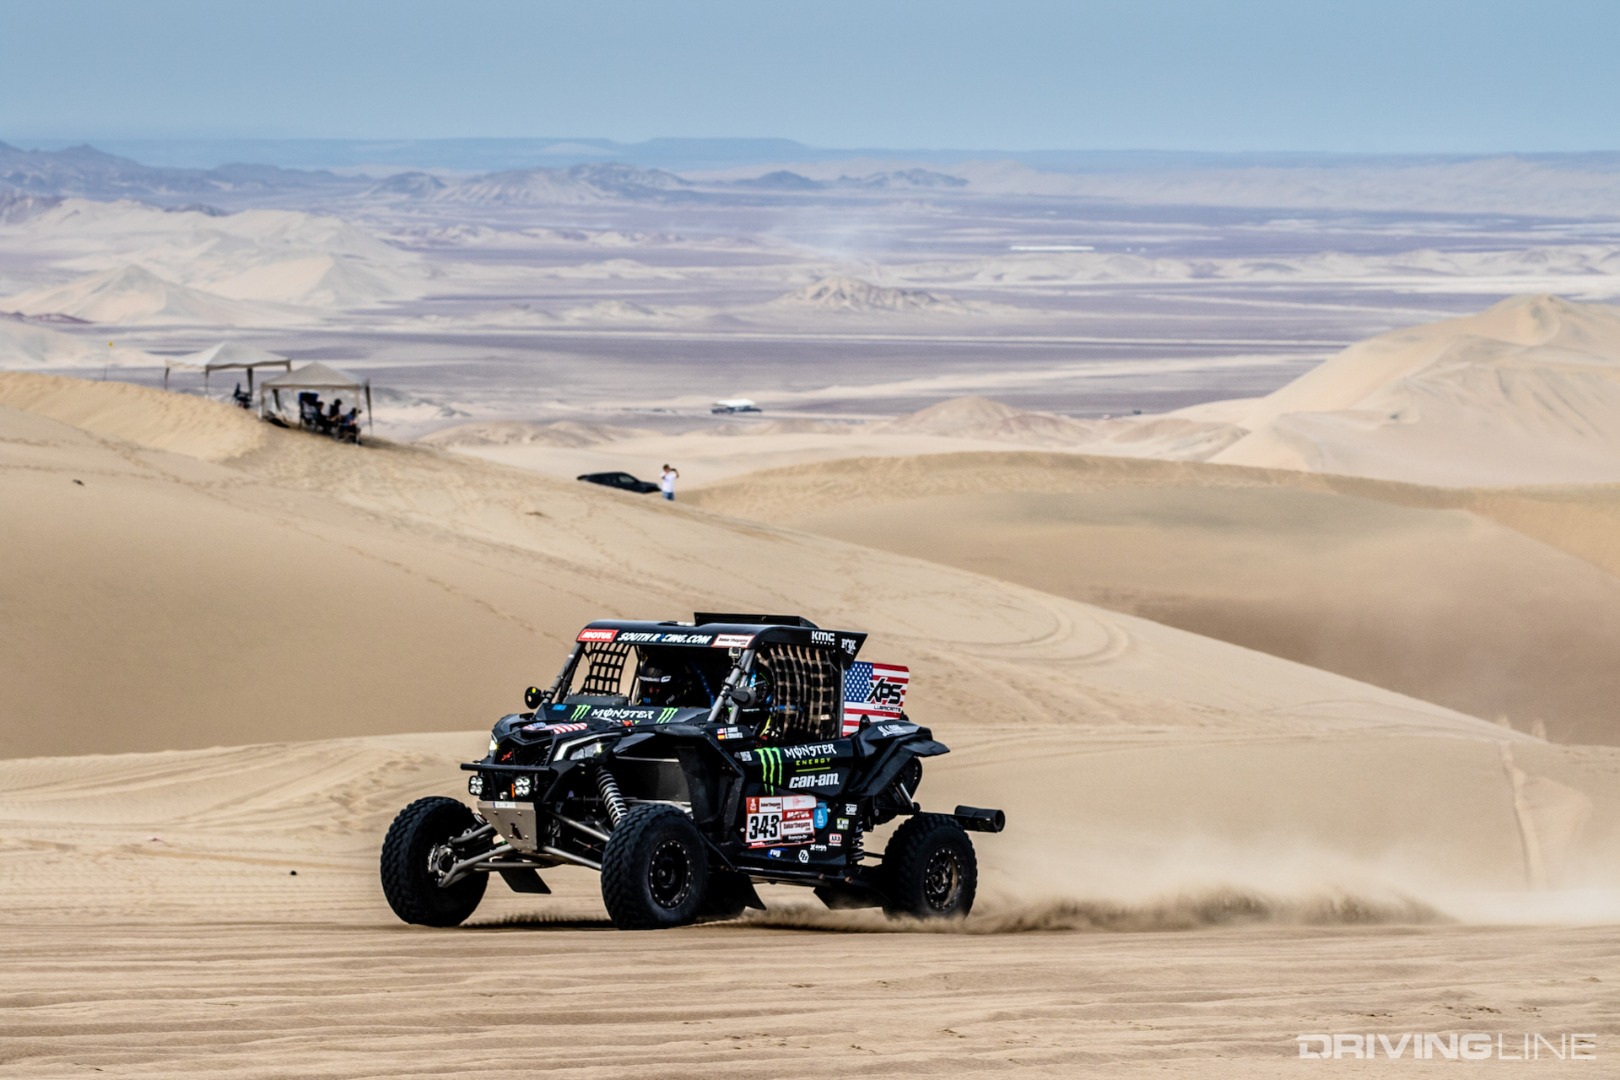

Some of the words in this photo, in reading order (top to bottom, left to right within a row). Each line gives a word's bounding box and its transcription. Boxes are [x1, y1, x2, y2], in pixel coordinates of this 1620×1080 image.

[582, 631, 613, 640] MOTUL
[811, 631, 835, 641] KMC
[866, 678, 903, 705] XPS
[591, 707, 655, 719] MONSTER
[784, 743, 837, 759] MONSTER
[796, 758, 831, 766] ENERGY
[786, 810, 810, 819] MOTUL
[749, 814, 780, 840] 343
